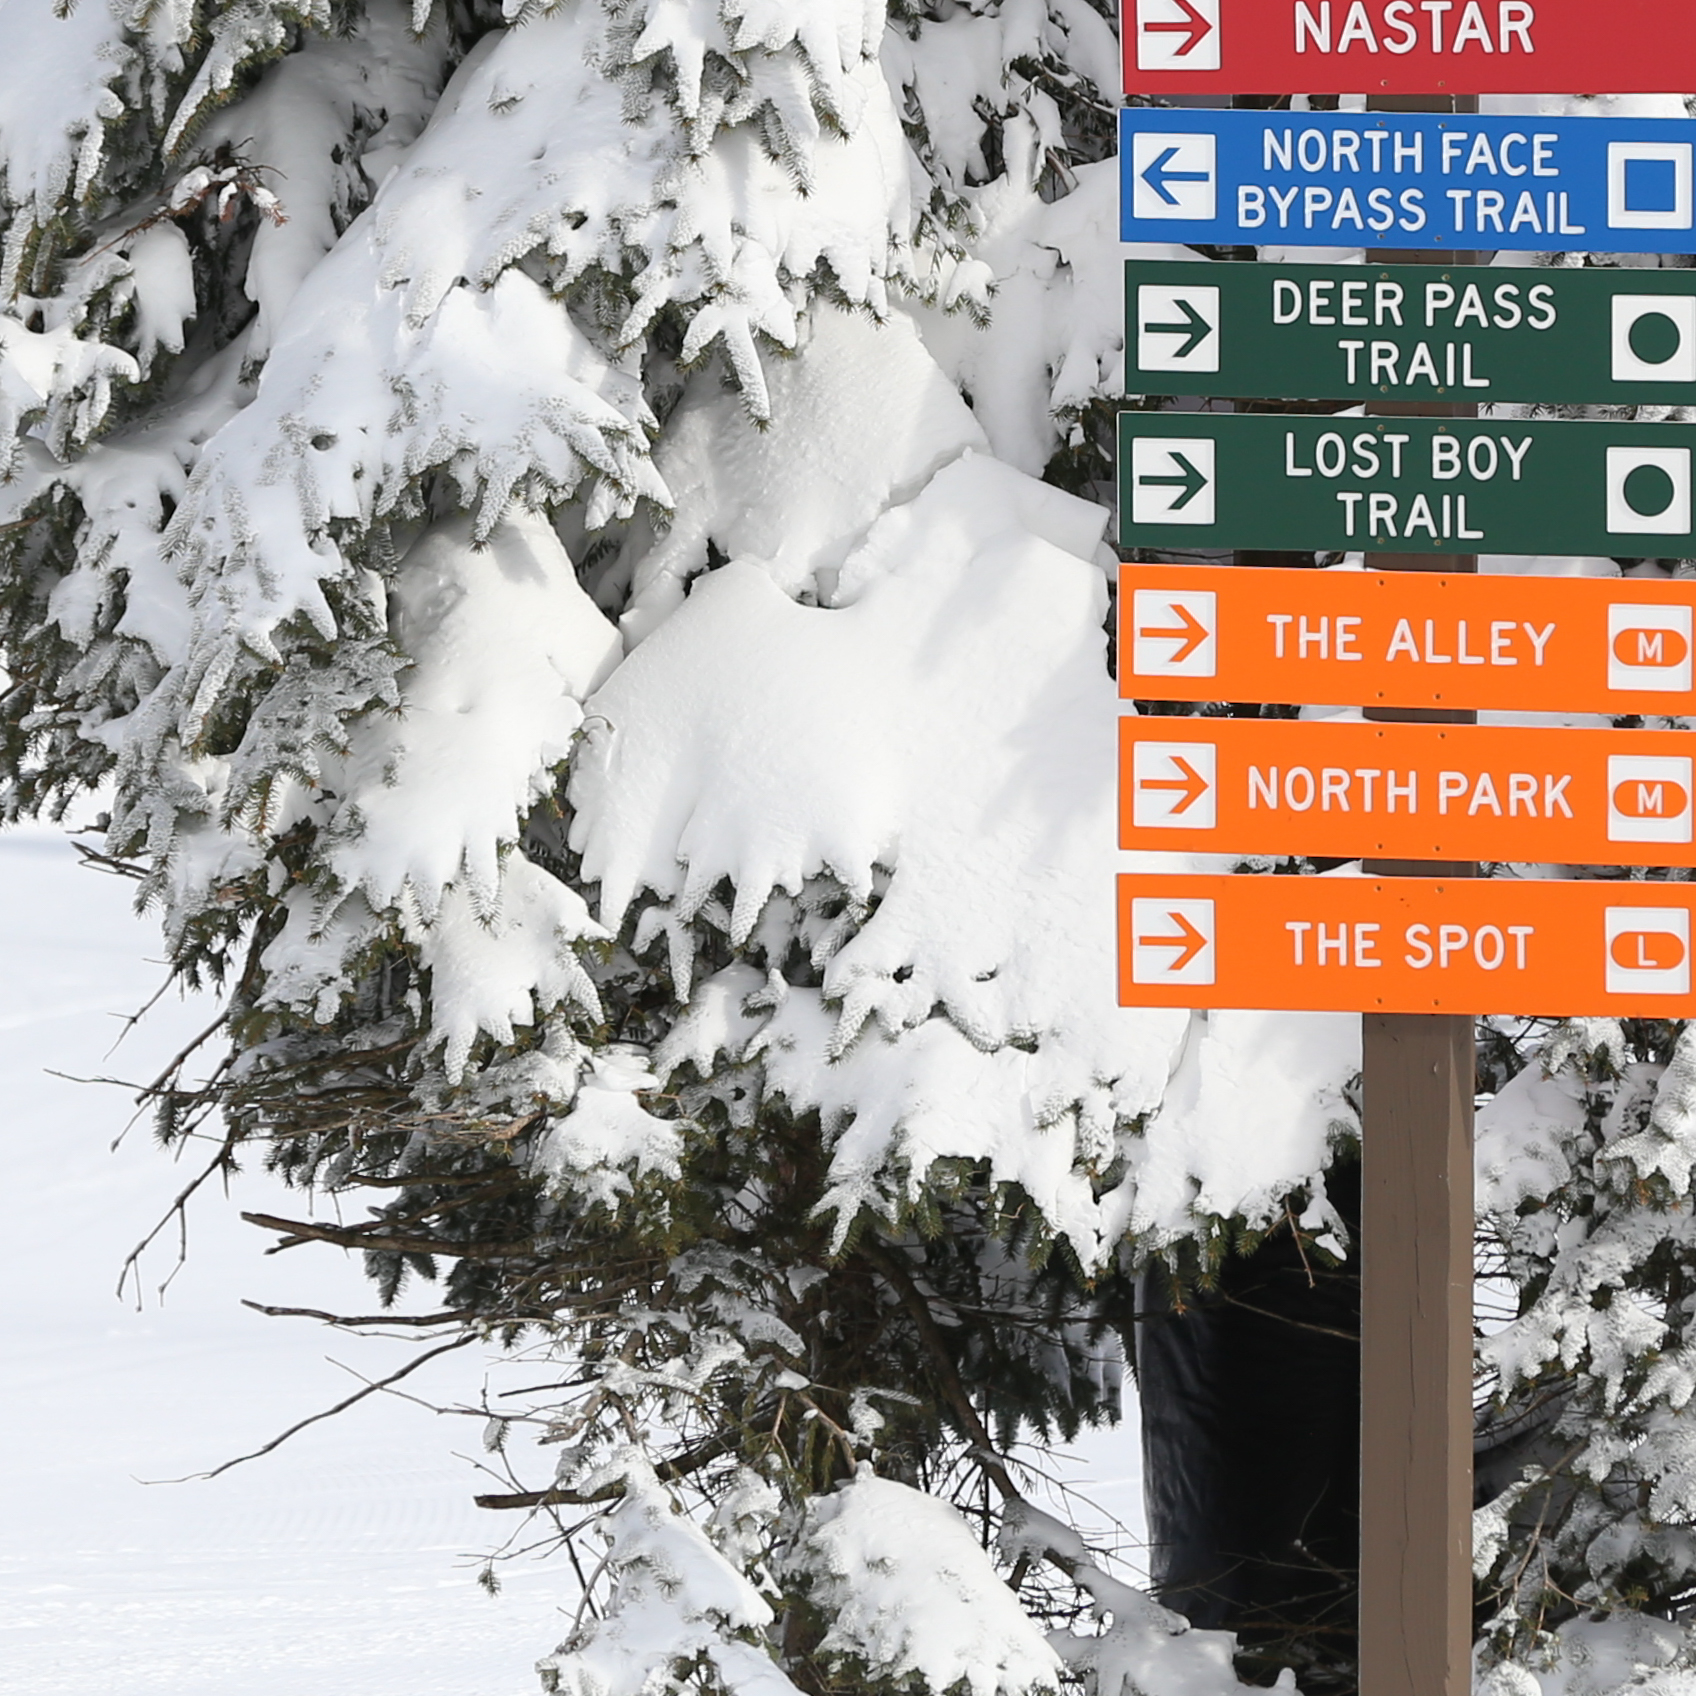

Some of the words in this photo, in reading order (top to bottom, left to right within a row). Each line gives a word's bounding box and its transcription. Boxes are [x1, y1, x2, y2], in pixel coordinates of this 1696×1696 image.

[1295, 0, 1534, 54] NASTAR
[1263, 128, 1423, 174] NORTH
[1442, 132, 1559, 177] FACE
[1237, 185, 1426, 232] BYPASS
[1446, 189, 1586, 235] TRAIL
[1273, 279, 1404, 326] DEER
[1425, 283, 1556, 330] PASS
[1338, 340, 1490, 387] TRAIL
[1286, 432, 1410, 478] LOST
[1432, 435, 1533, 481] BOY
[1336, 492, 1484, 539] TRAIL
[1266, 613, 1363, 661] THE
[1385, 618, 1556, 666] ALLEY
[1637, 631, 1663, 663] M
[1248, 765, 1417, 814] NORTH
[1438, 771, 1574, 819] PARK
[1637, 783, 1663, 814] M
[1285, 921, 1382, 968] THE
[1404, 923, 1535, 971] SPOT
[1637, 934, 1658, 967] L
